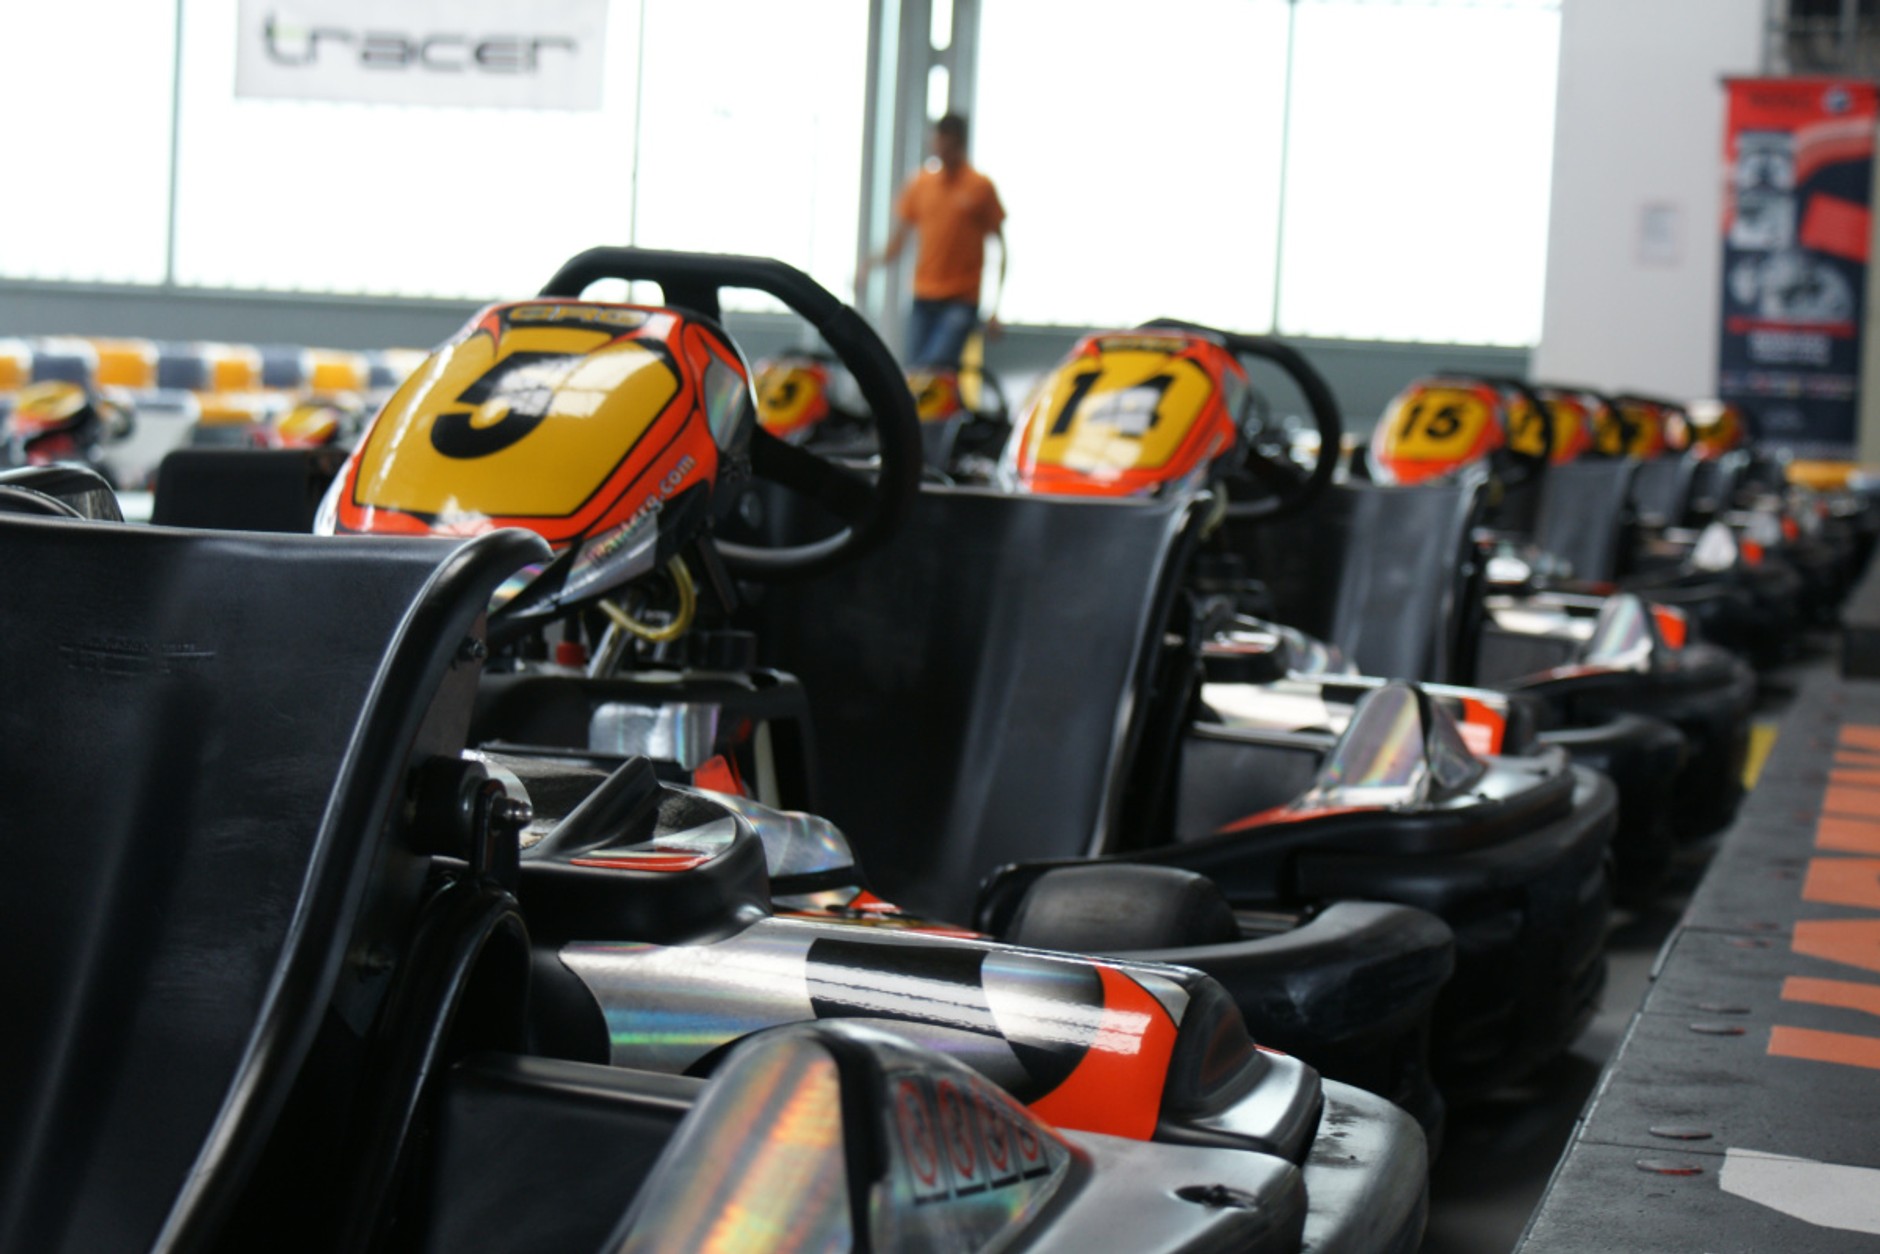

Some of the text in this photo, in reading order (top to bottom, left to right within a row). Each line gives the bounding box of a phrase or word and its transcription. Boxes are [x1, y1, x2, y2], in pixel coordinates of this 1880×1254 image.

[262, 8, 578, 75] tracer
[1050, 371, 1176, 438] 14
[1401, 402, 1467, 440] 15
